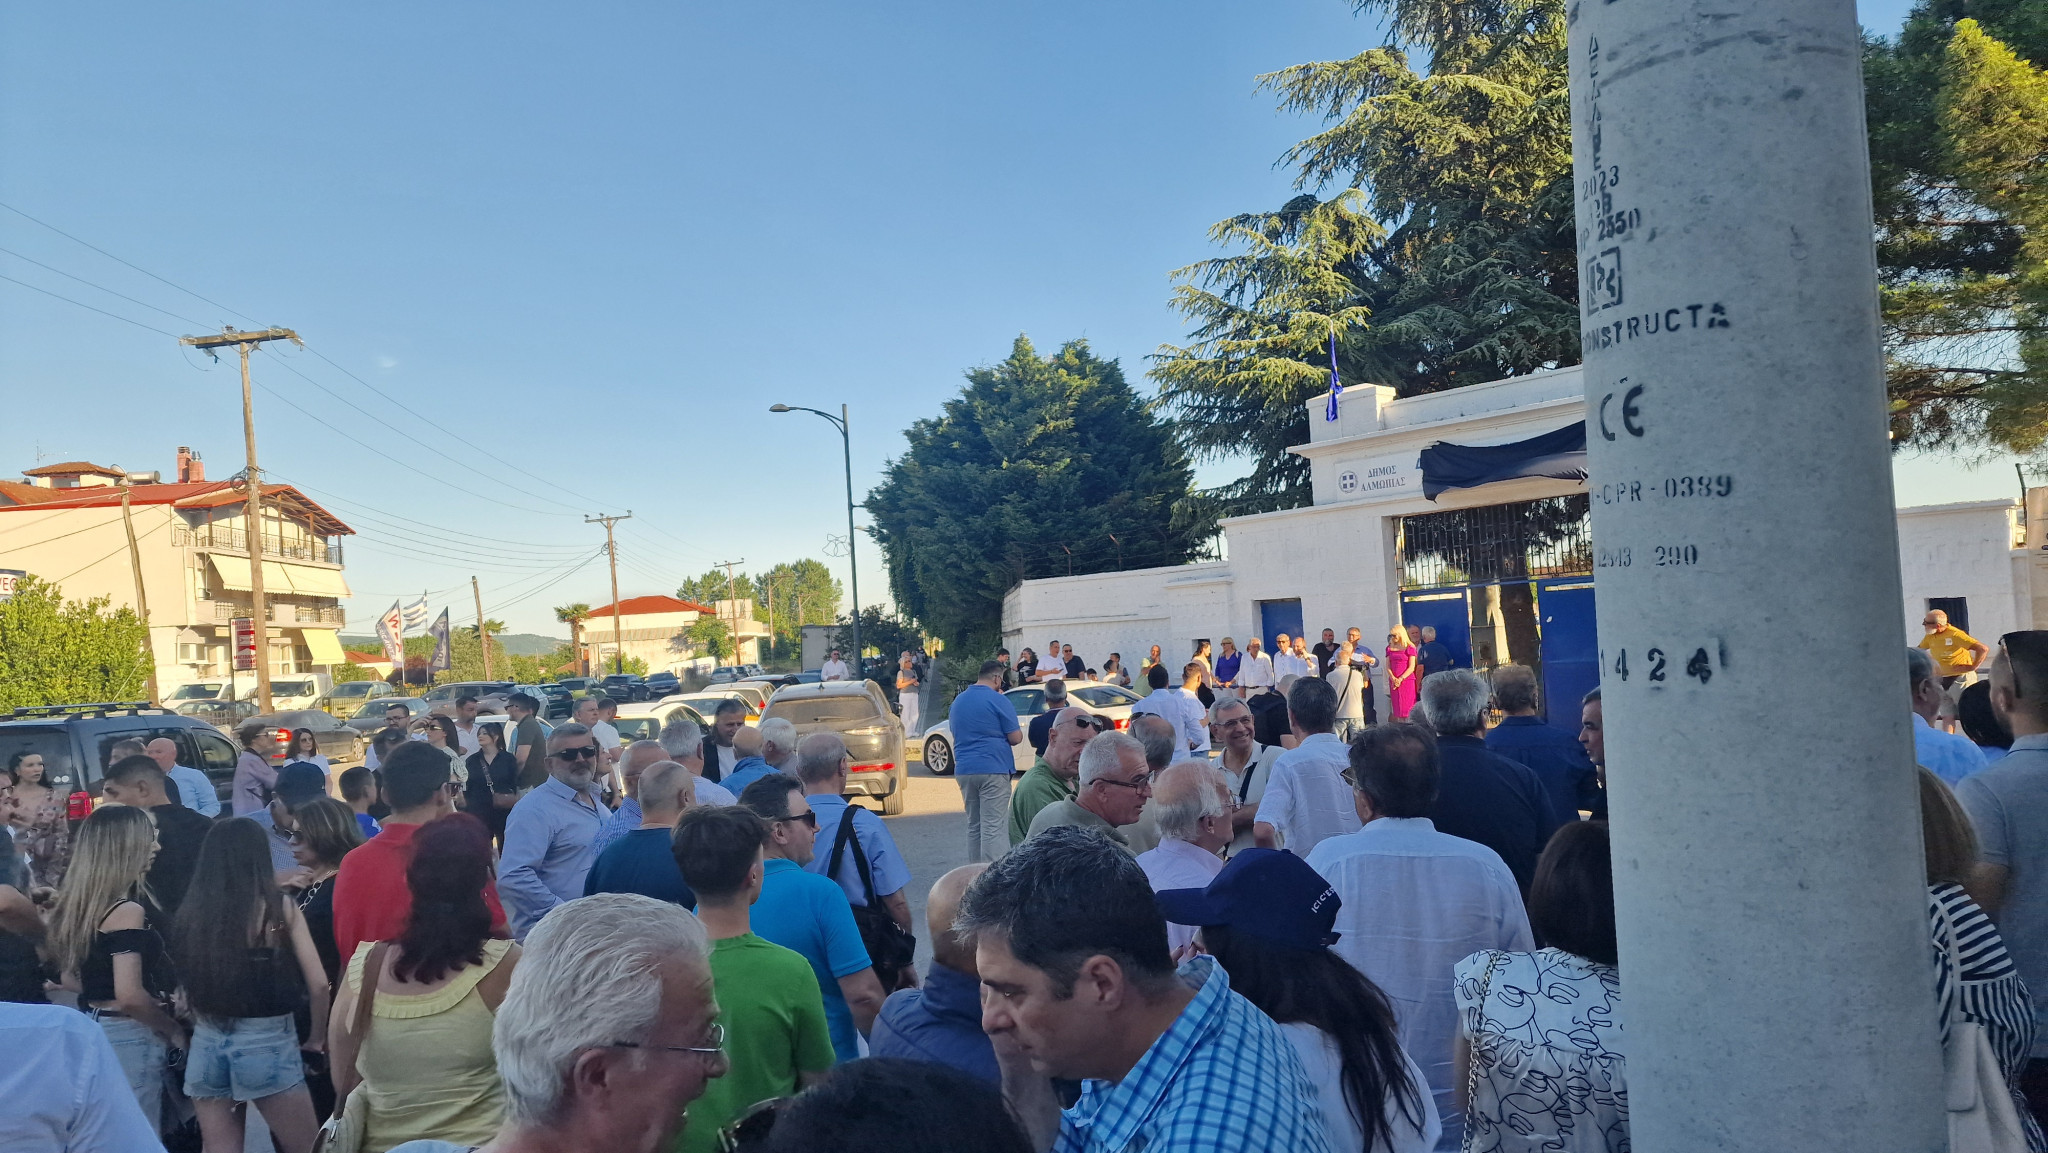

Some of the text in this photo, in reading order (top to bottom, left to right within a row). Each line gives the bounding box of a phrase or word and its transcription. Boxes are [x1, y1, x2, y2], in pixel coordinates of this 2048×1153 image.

[1582, 165, 1619, 202] 2023
[1582, 303, 1730, 355] ONSTRUCTA
[1600, 384, 1645, 441] CE
[1361, 477, 1406, 491] ΑΛΜΩΠΙΑΣ
[1368, 465, 1397, 478] ΔΗΜΟΣ
